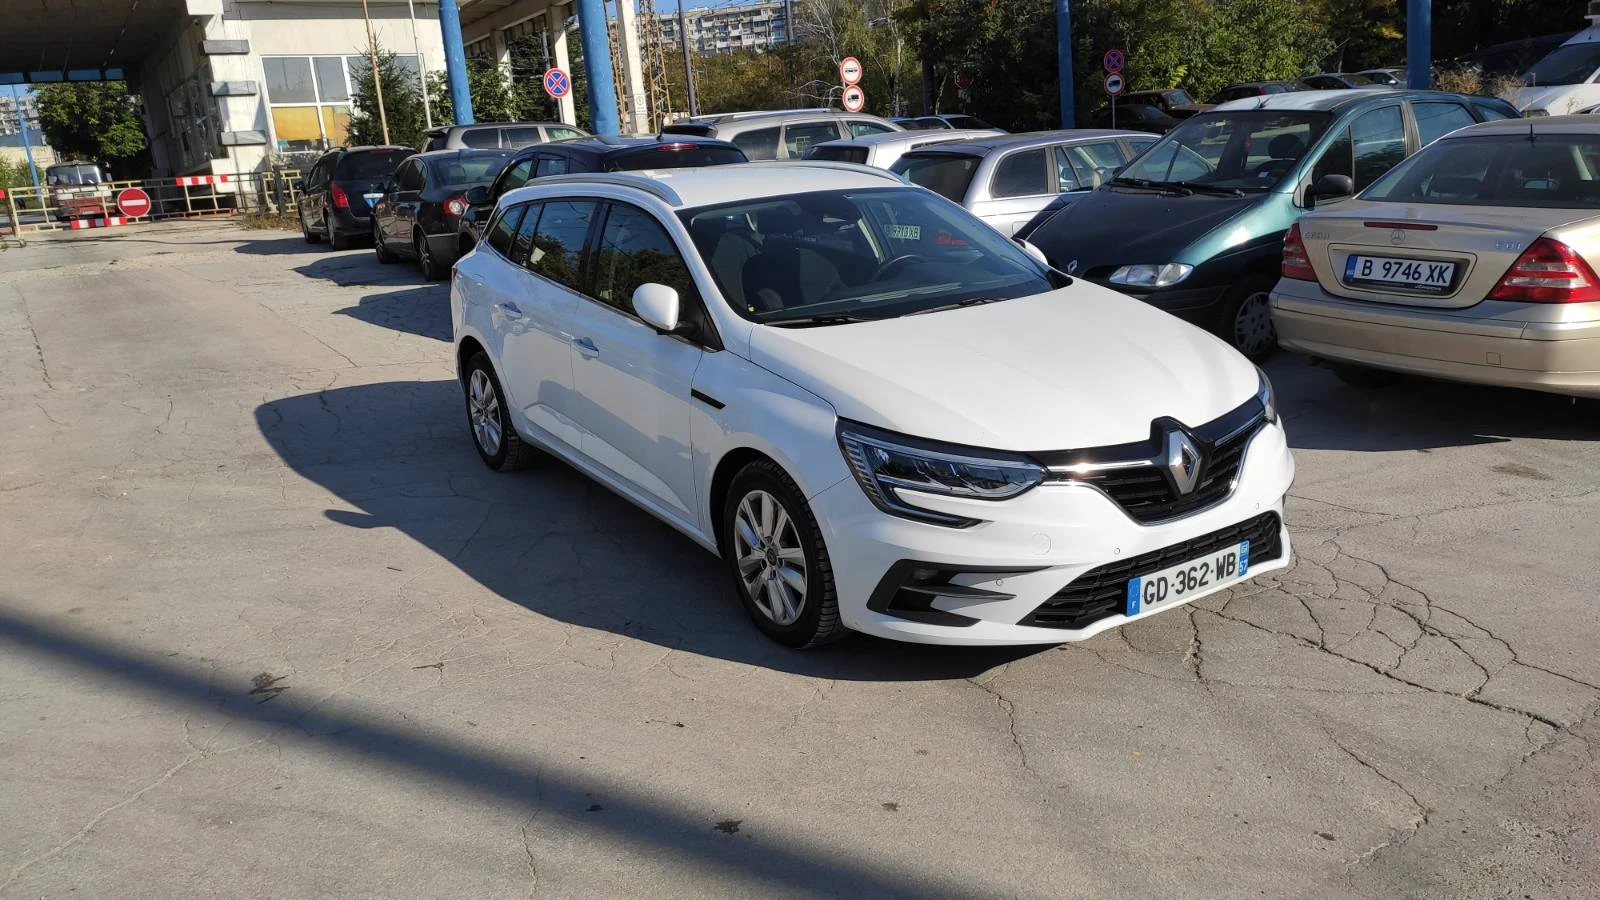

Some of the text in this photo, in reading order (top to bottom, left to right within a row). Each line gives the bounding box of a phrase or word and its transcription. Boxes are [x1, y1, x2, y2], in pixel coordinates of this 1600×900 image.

[1361, 259, 1450, 284] B 9746 XK
[1239, 559, 1249, 574] 57
[1131, 600, 1137, 609] F
